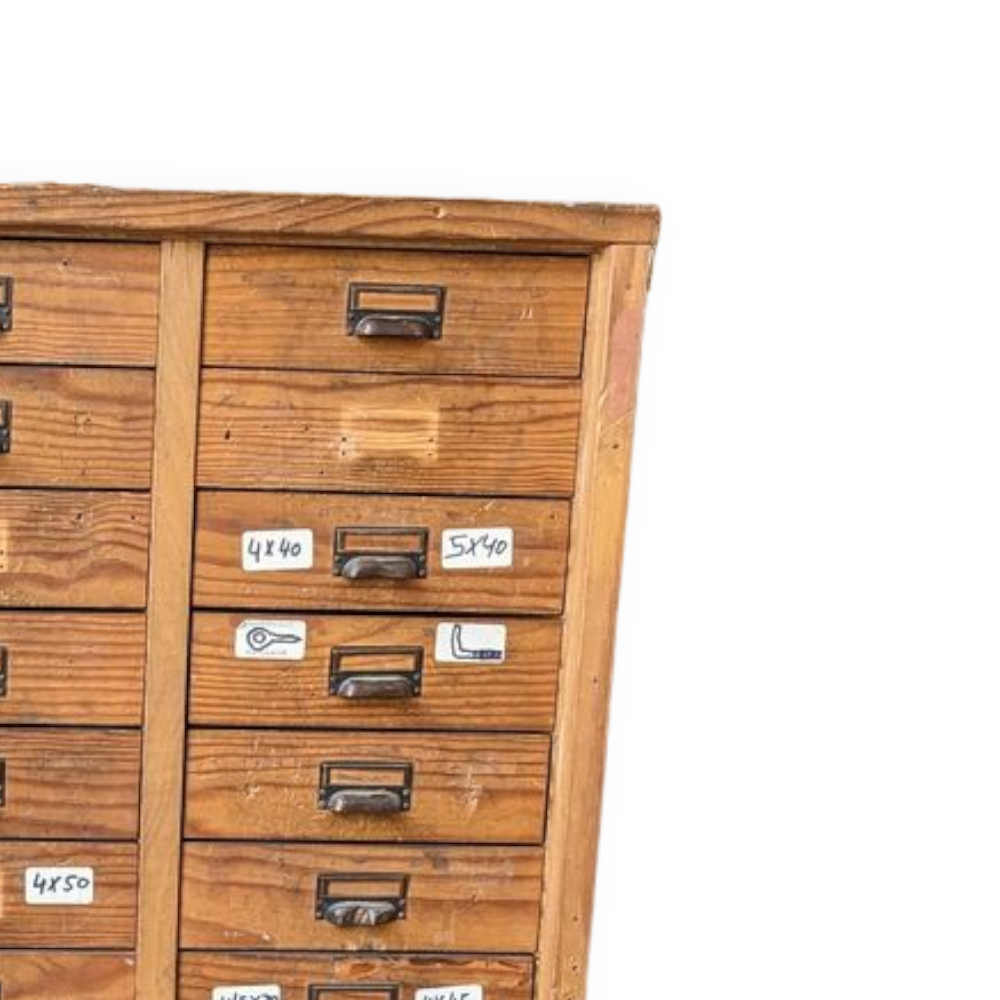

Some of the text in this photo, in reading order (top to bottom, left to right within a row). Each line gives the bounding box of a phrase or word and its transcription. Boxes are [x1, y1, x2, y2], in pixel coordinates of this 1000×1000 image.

[248, 538, 301, 563] 4X40
[445, 534, 507, 558] 5X40
[33, 873, 90, 895] 4X50
